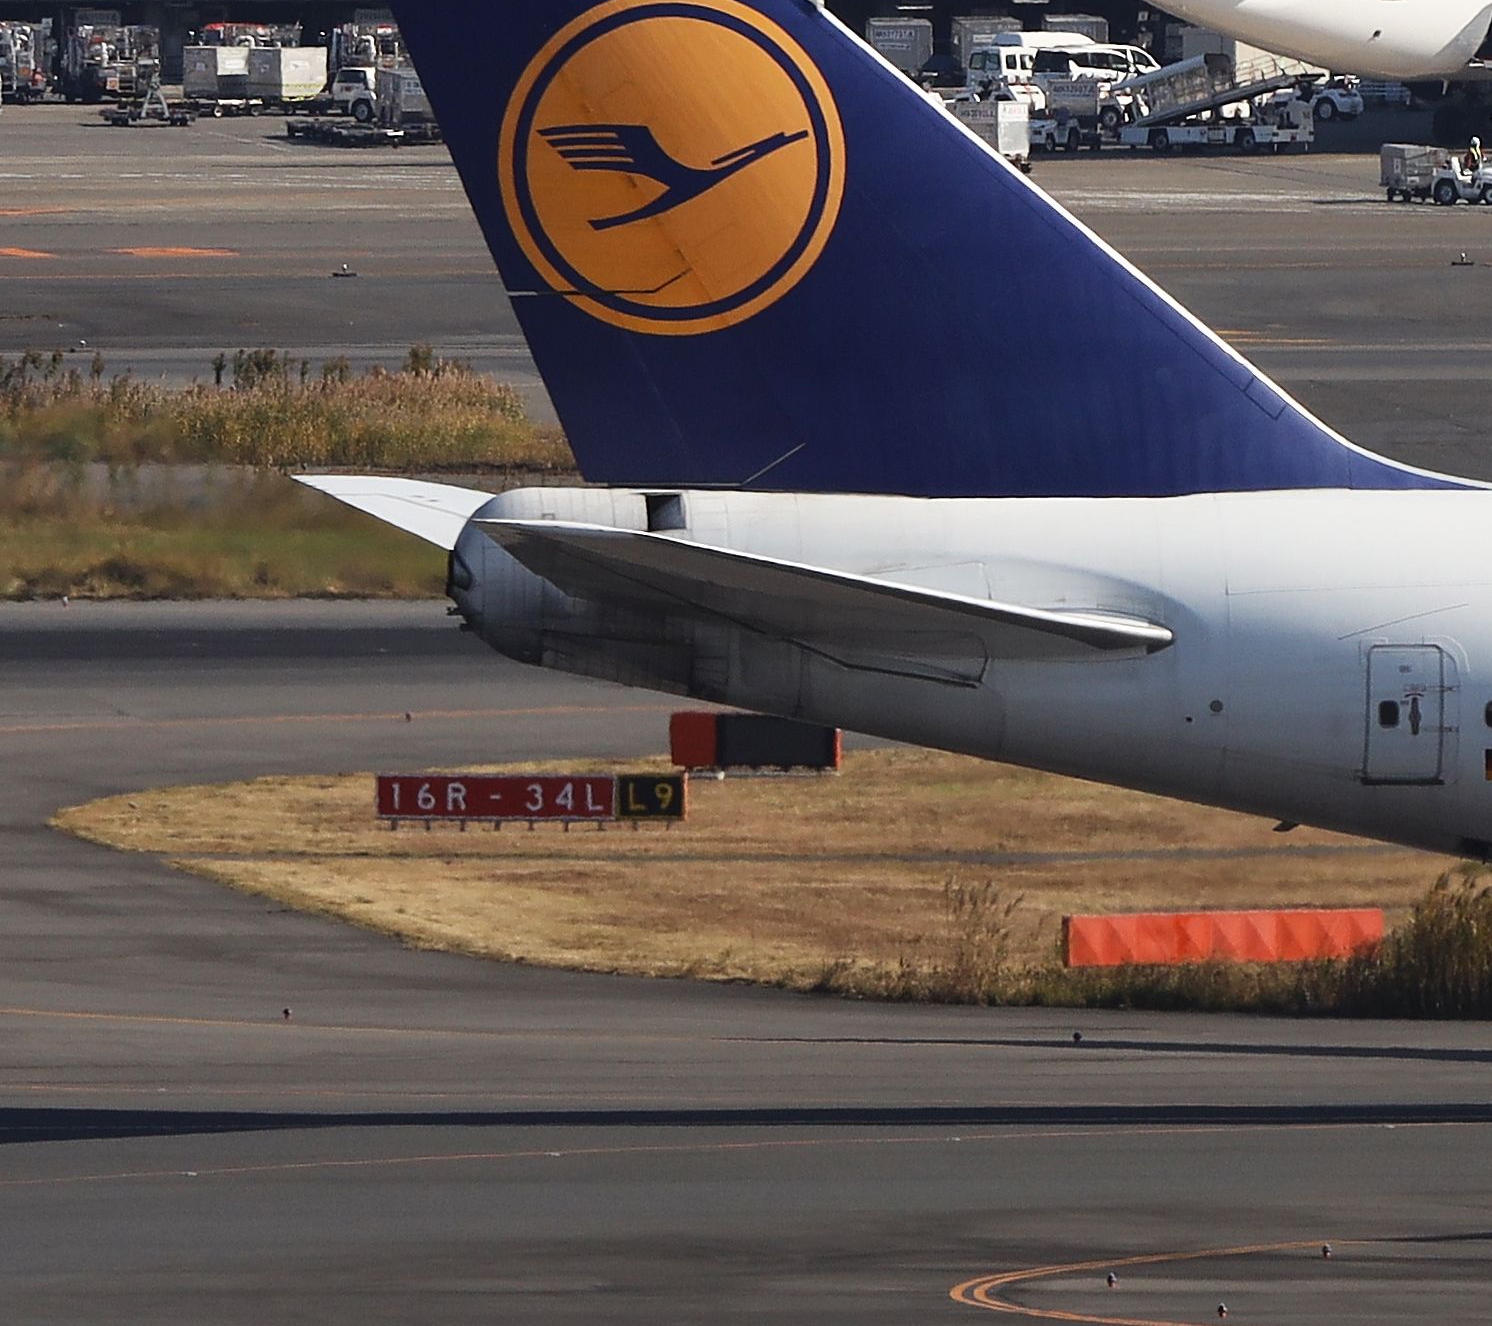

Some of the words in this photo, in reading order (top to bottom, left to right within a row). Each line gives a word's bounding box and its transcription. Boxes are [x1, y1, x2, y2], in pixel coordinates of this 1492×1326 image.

[391, 782, 468, 811] 16R
[525, 782, 604, 811] 34L
[629, 783, 674, 810] L9
